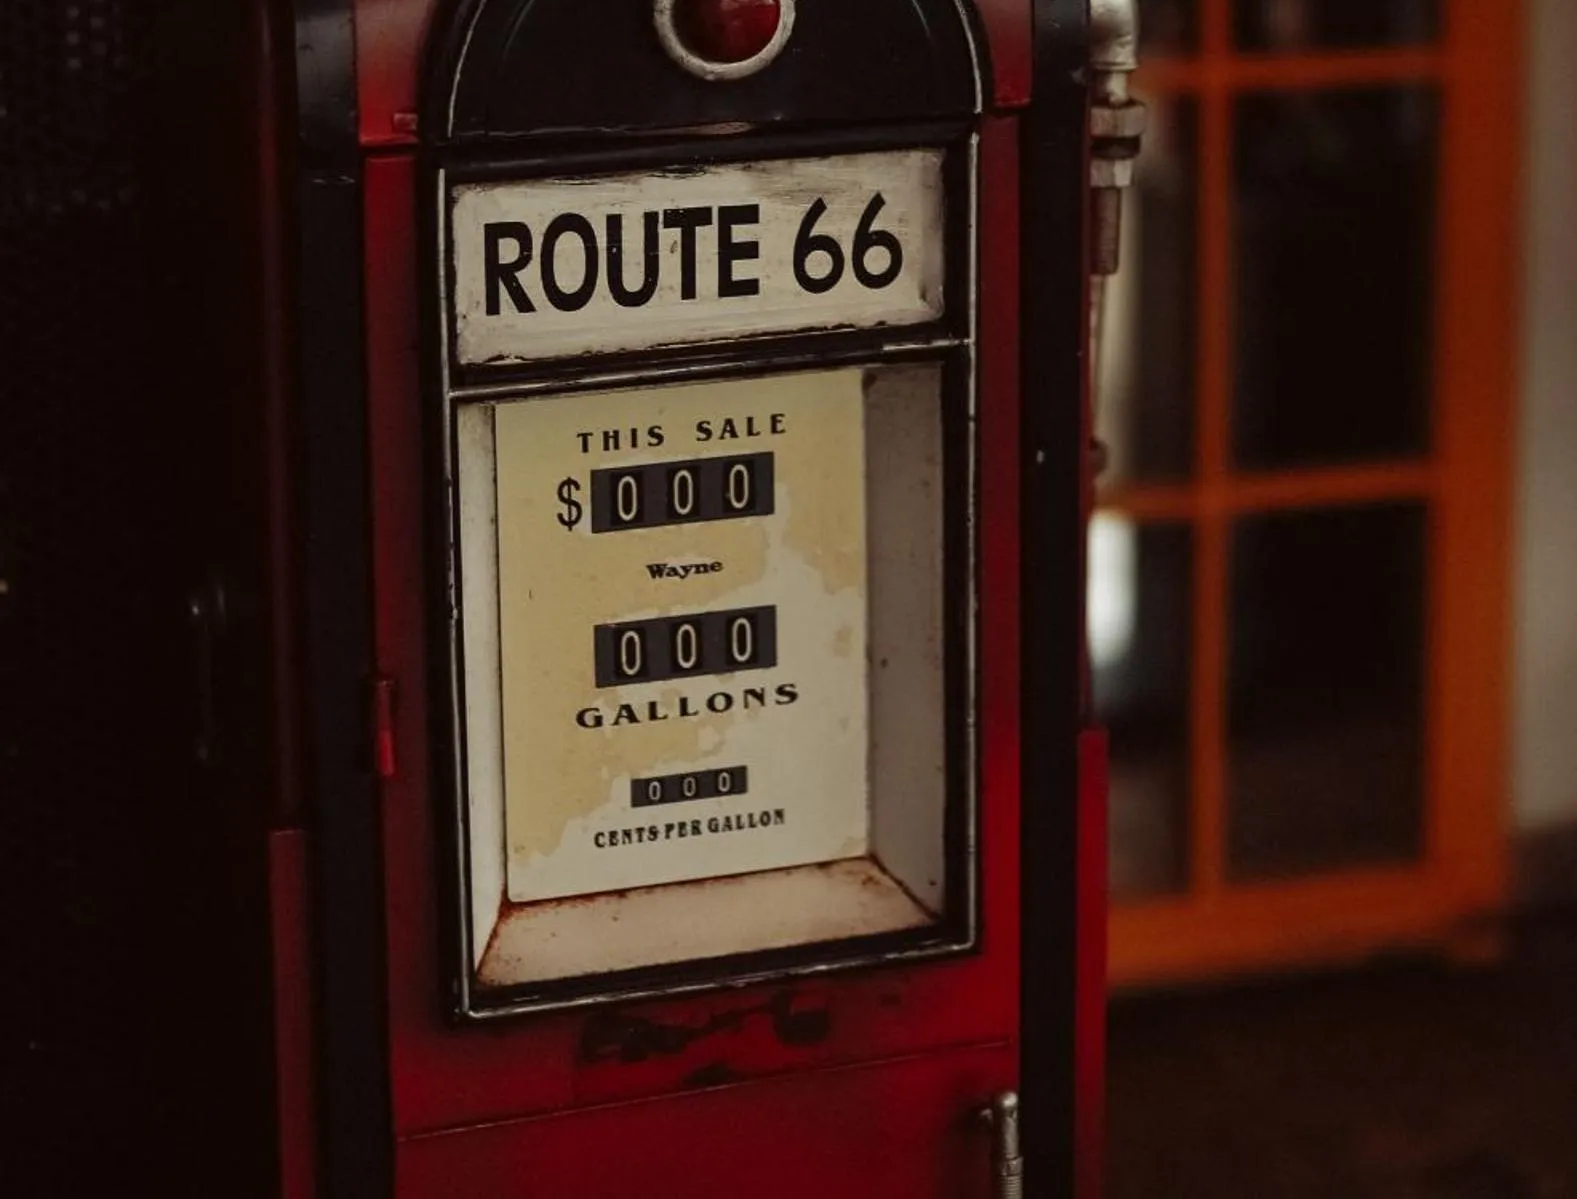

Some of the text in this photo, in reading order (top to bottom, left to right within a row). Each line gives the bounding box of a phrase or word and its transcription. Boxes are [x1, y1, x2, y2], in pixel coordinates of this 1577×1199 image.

[483, 192, 903, 316] ROUTE 66
[576, 413, 786, 453] THIS SALE
[646, 560, 724, 580] Wayne
[575, 683, 799, 729] GALLONS
[593, 808, 786, 849] CENTS PER GALLON
